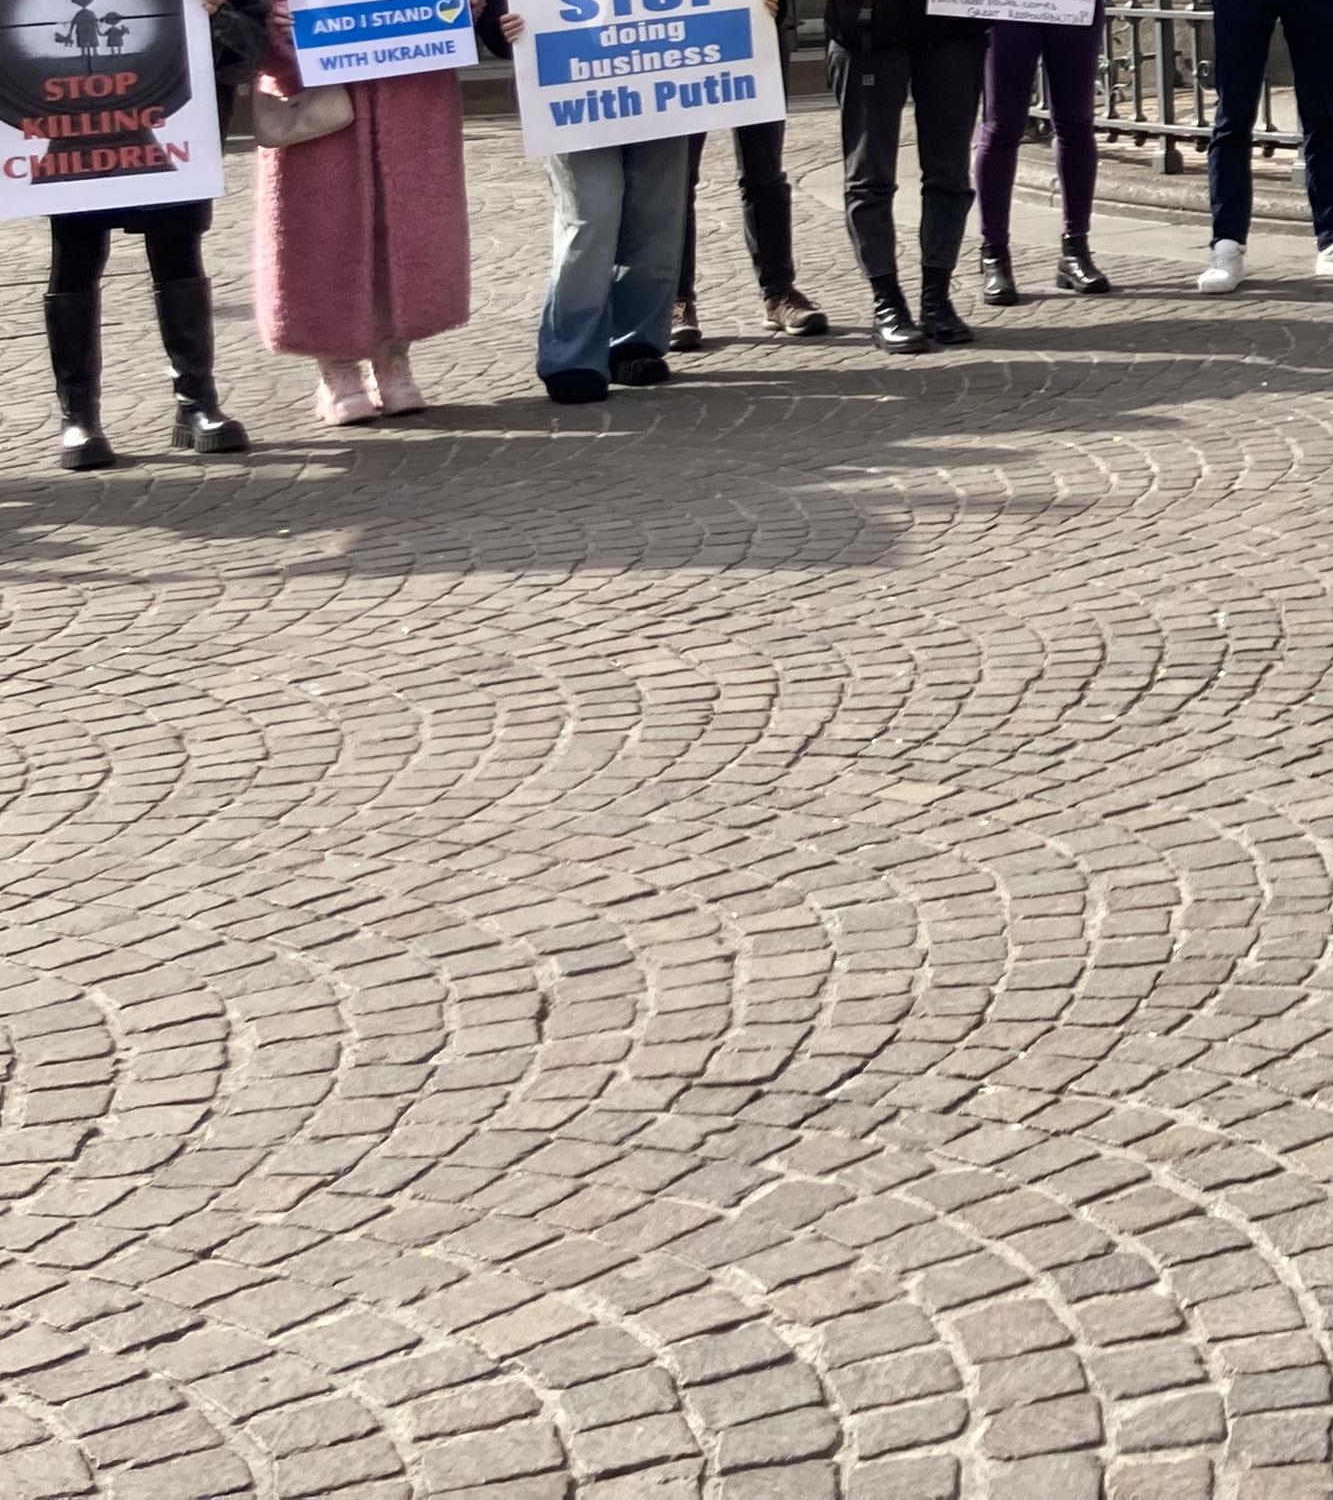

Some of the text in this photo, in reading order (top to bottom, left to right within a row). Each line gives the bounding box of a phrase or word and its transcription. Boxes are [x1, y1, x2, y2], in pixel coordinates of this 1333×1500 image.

[312, 6, 433, 35] AND I STAND
[599, 20, 686, 47] doing
[319, 40, 456, 71] WITH UKRAINE
[570, 43, 721, 82] business
[43, 72, 139, 101] STOP
[550, 71, 757, 127] with Putin
[19, 106, 166, 140] KILLING
[3, 141, 190, 180] CHILDREN
